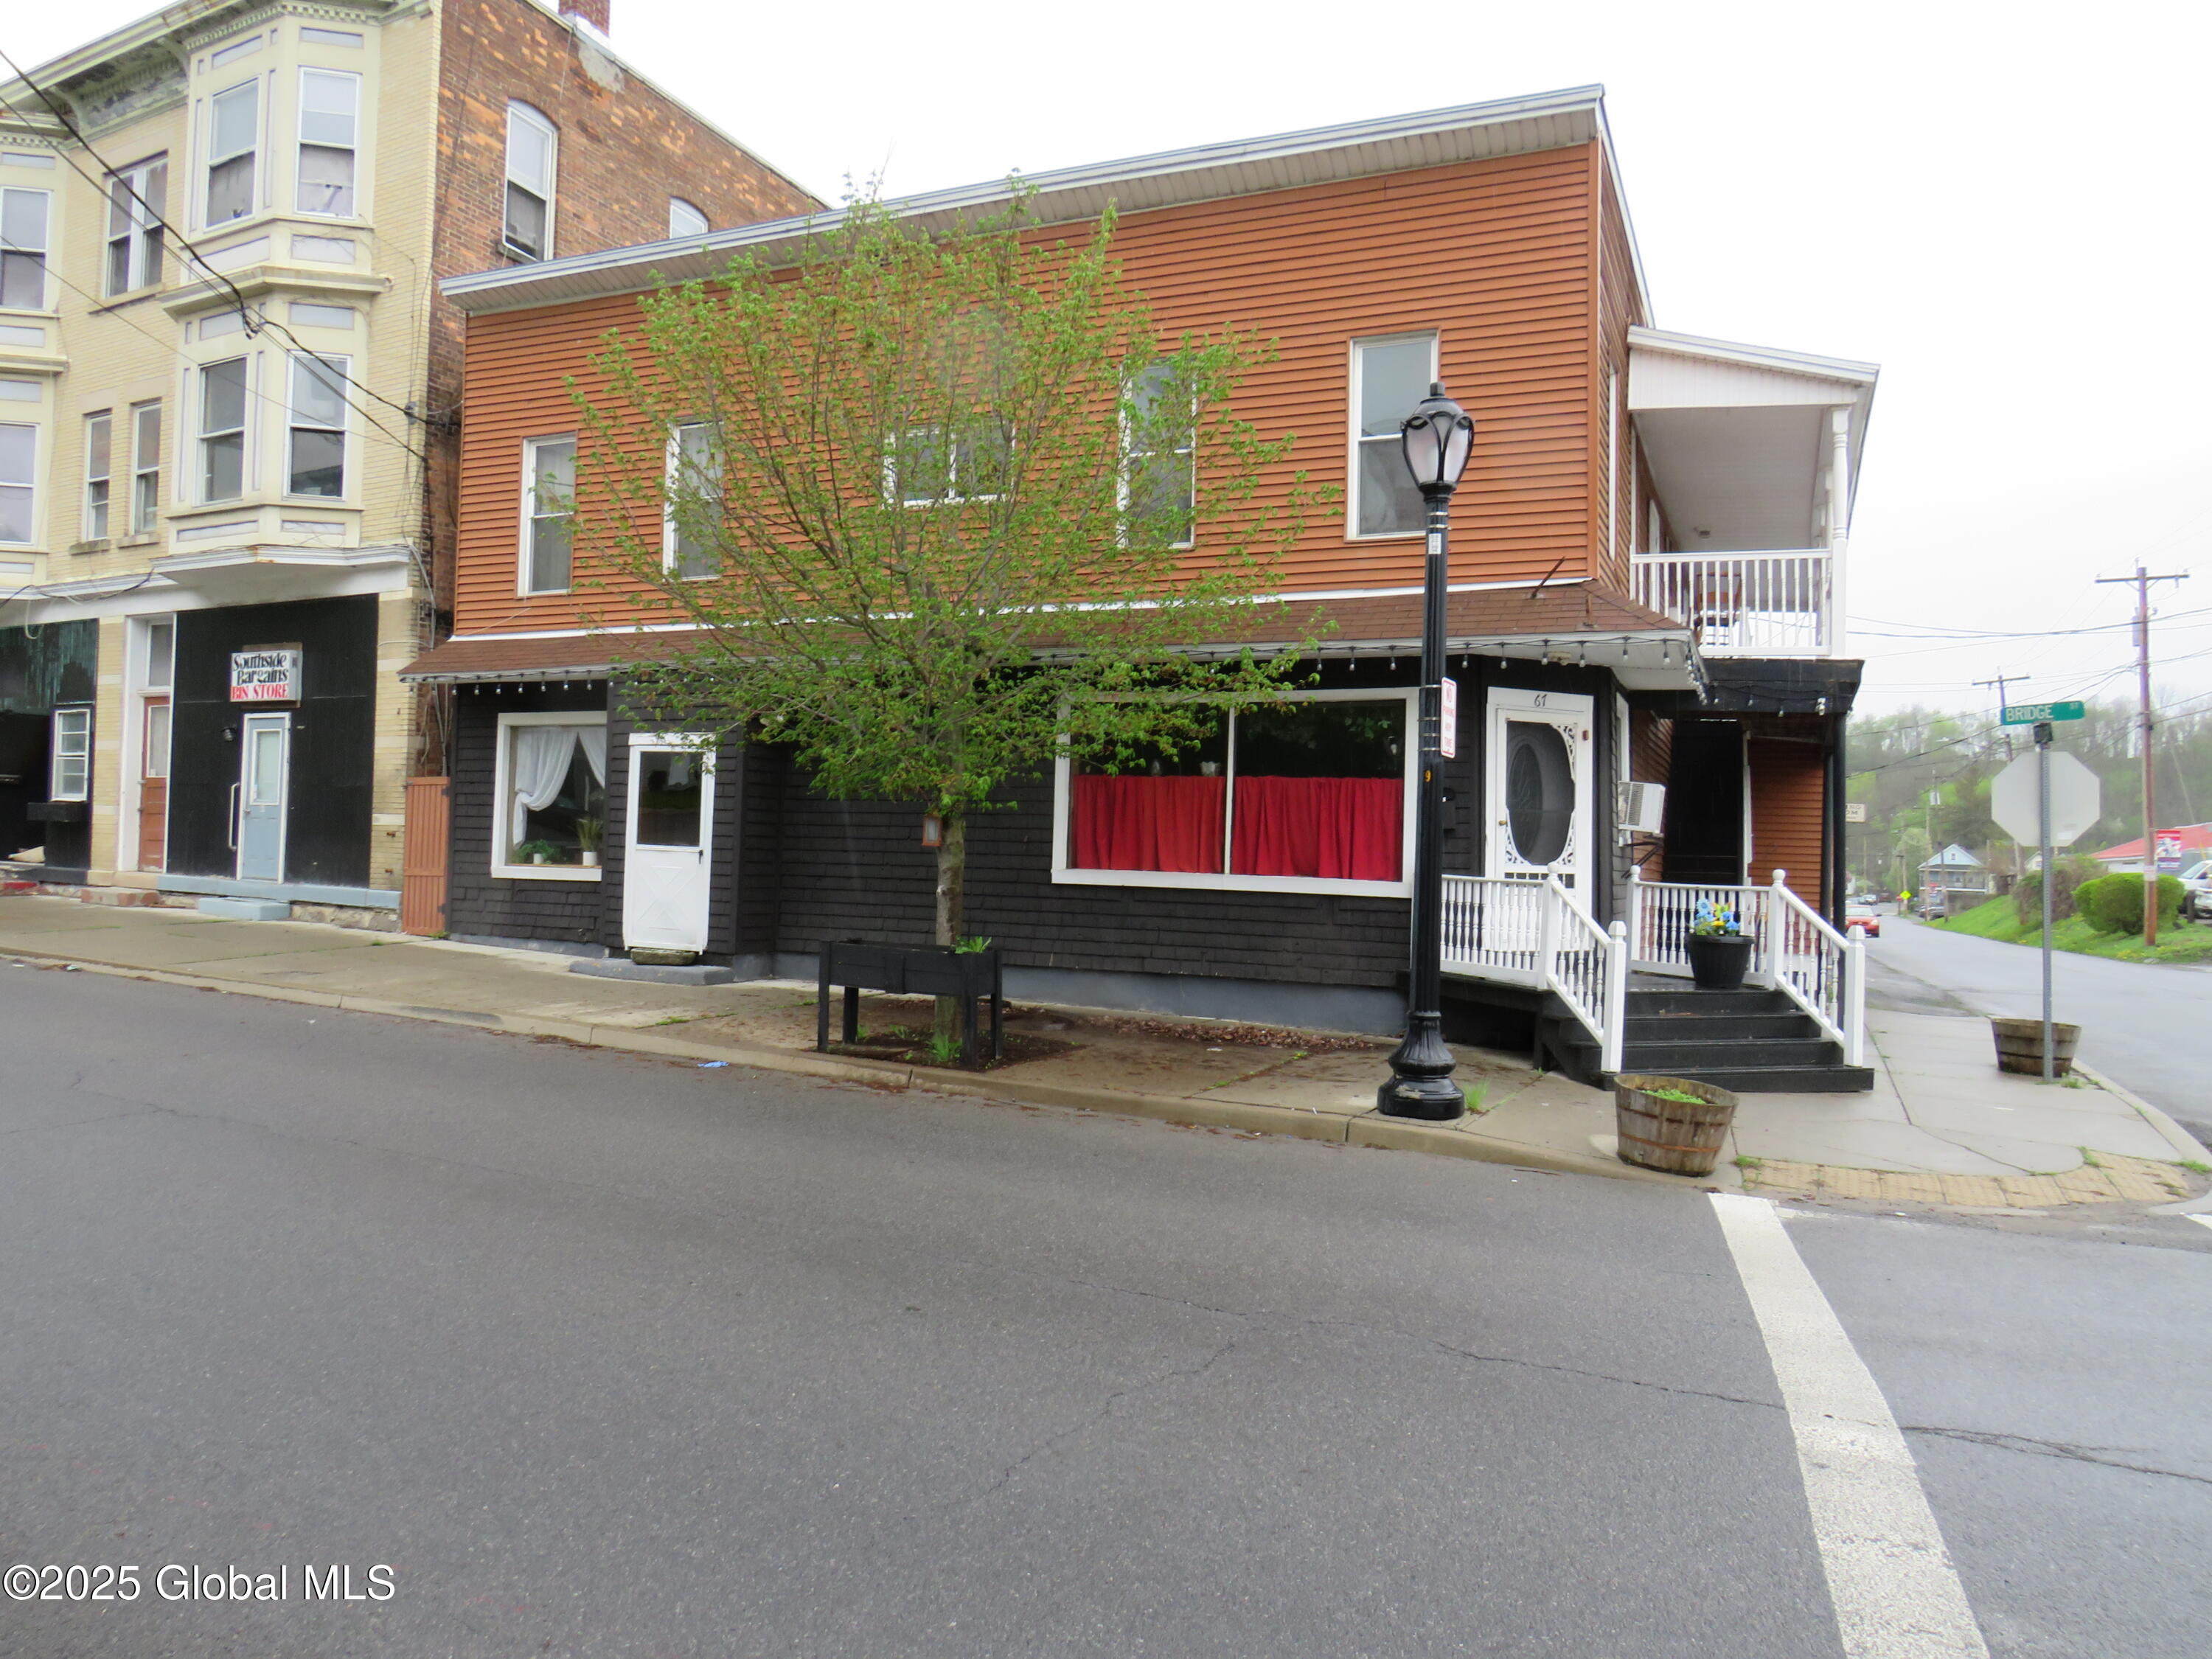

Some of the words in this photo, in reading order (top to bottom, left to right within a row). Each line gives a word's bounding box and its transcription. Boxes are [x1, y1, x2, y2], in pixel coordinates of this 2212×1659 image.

[233, 653, 287, 671] Southside
[237, 668, 288, 686] Bargains
[232, 686, 249, 700] BIN
[254, 684, 288, 699] STORE
[2006, 704, 2053, 722] BRIDGE
[1425, 770, 1431, 782] 9
